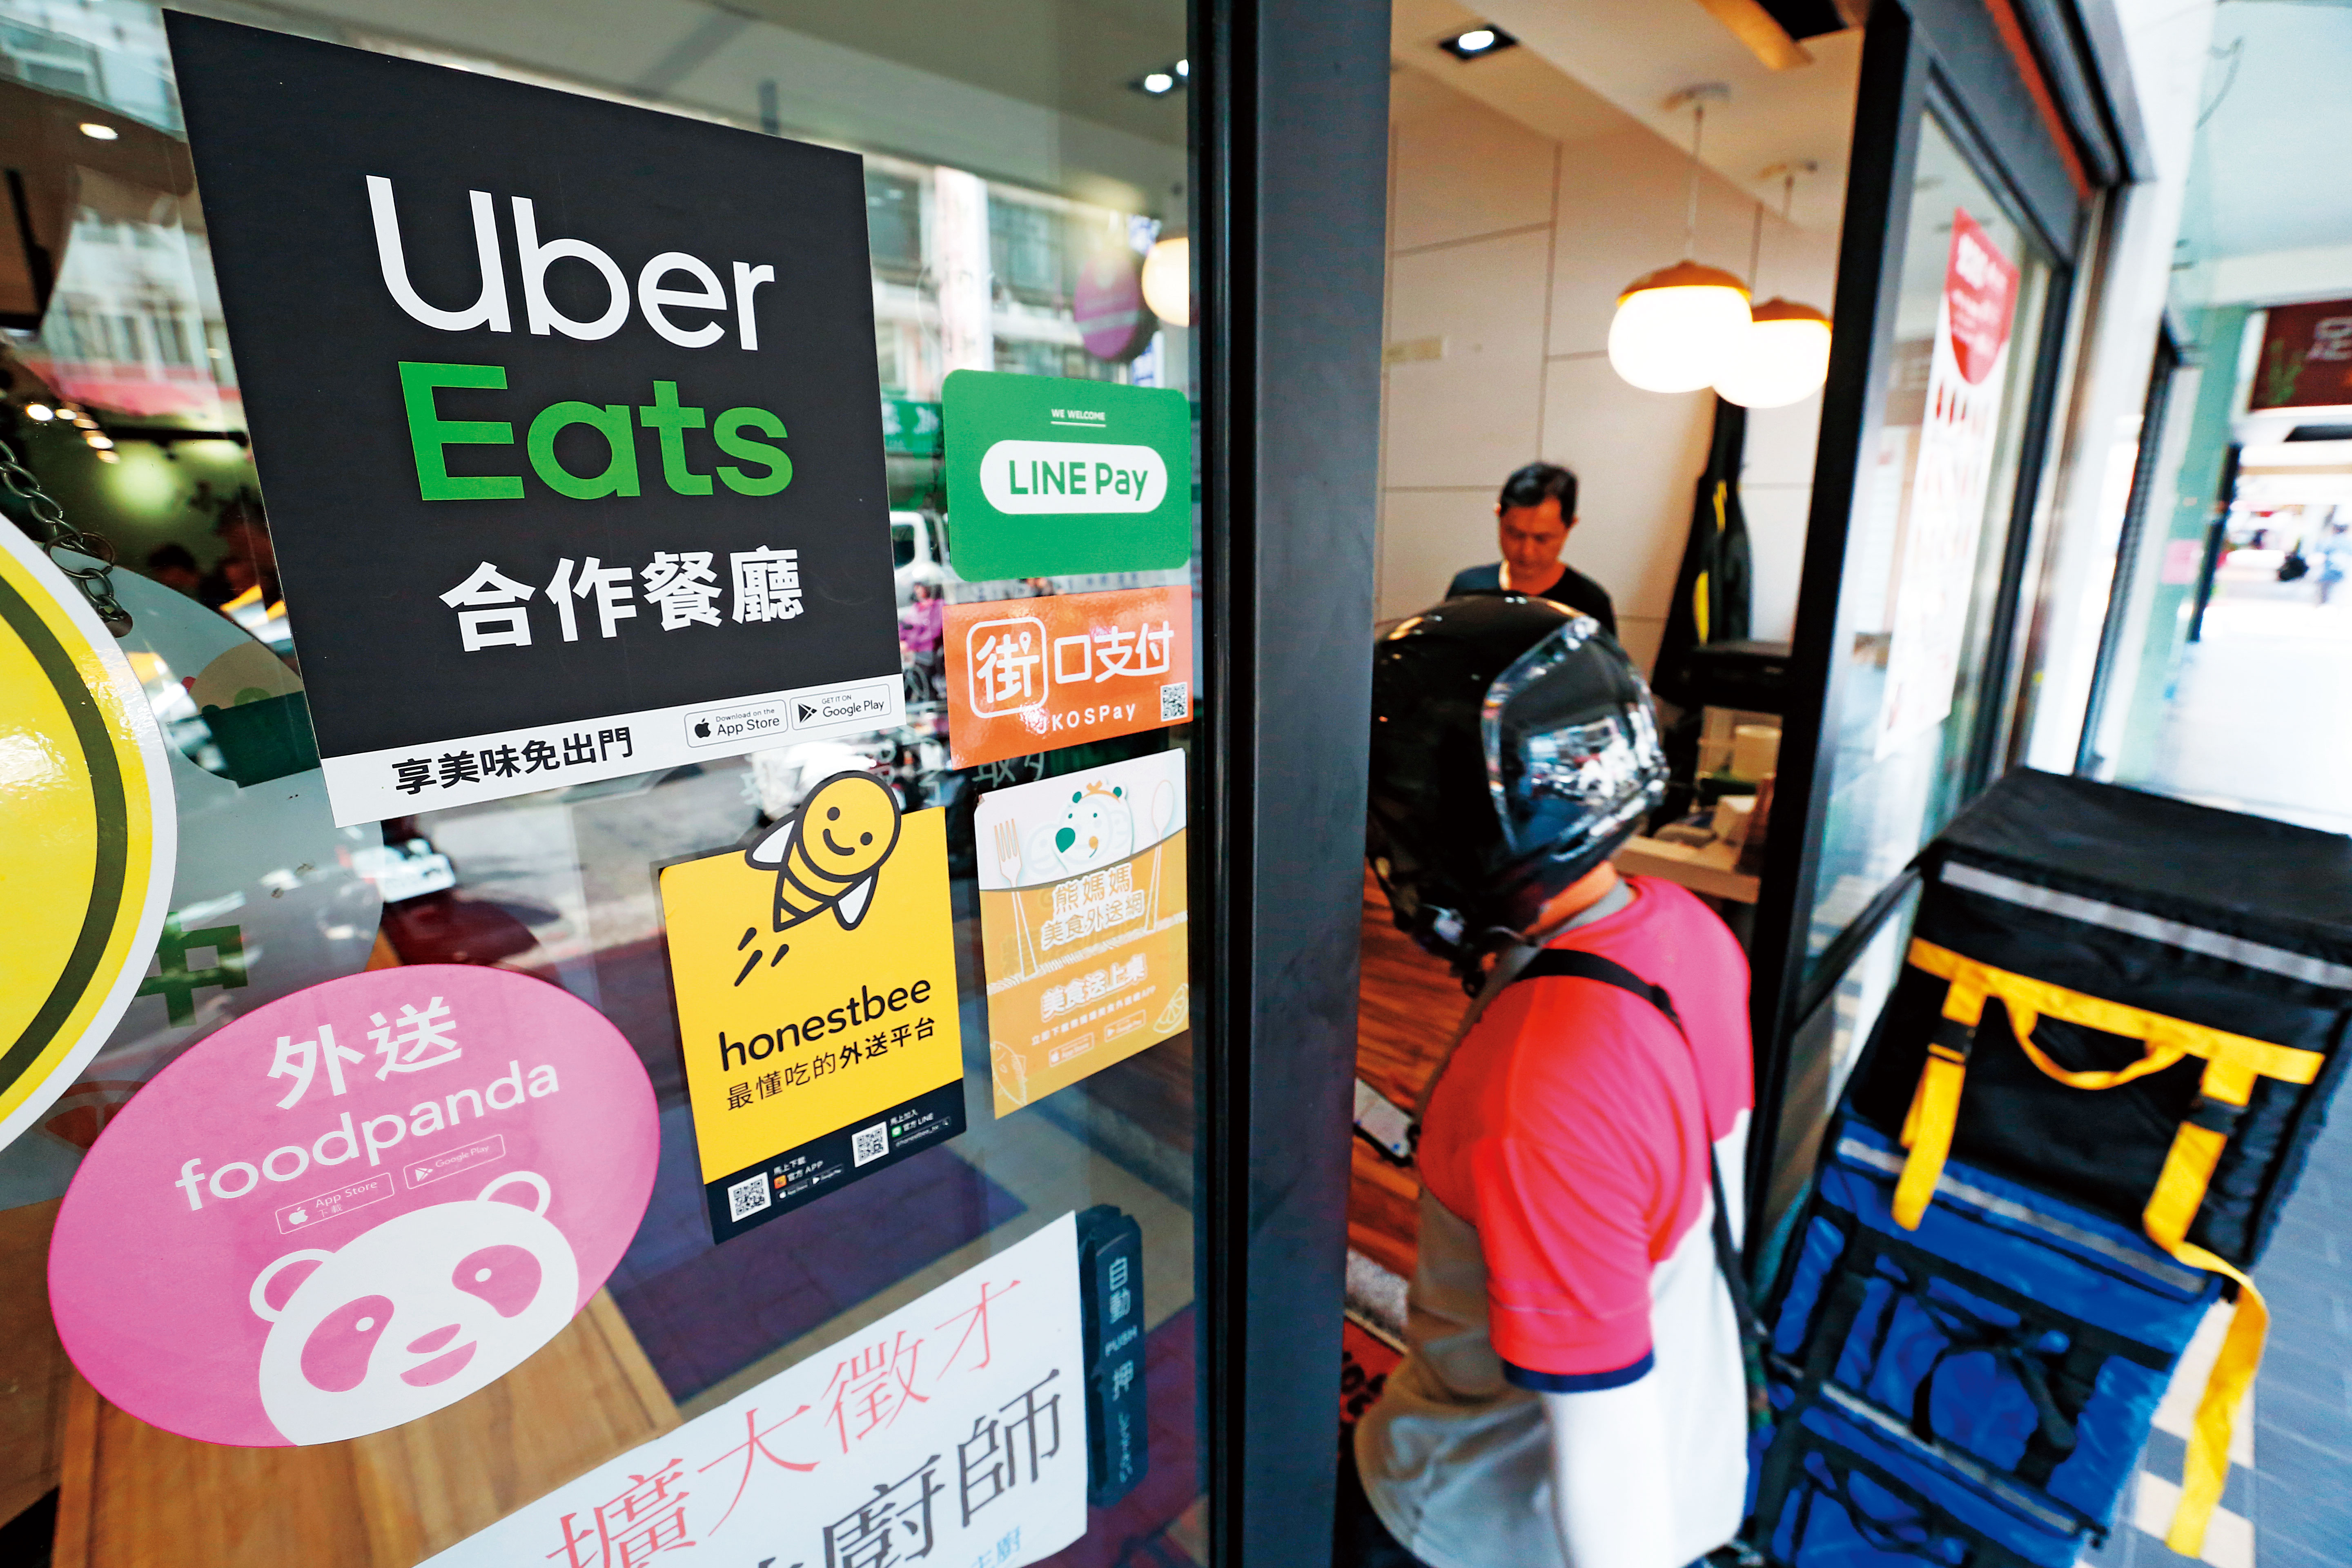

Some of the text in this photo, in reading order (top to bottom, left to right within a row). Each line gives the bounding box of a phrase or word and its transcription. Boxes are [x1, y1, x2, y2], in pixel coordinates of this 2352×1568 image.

[365, 175, 775, 350] Uber
[398, 361, 793, 500] Eats
[1051, 409, 1105, 421] WE WELCOME
[1009, 460, 1148, 501] LINE Pay
[439, 545, 804, 652] 合作餐廳
[975, 620, 1174, 704] 街口支付
[716, 711, 751, 722] Download
[717, 717, 780, 737] App Store
[823, 699, 884, 718] Google Play
[1036, 703, 1136, 735] JKOSPay
[392, 726, 633, 796] 享美味免出門
[1043, 892, 1143, 948] 美食外送網
[1054, 864, 1131, 915] 熊媽媽
[266, 996, 462, 1110] 外送
[718, 980, 931, 1071] honestbee
[727, 1017, 935, 1111] 最懂吃的外送平台
[175, 1060, 560, 1211] foodpanda
[435, 1152, 470, 1167] Google
[470, 1145, 490, 1156] Play
[316, 1182, 377, 1208] App Store
[1109, 1255, 1131, 1325] 自動
[547, 1280, 1021, 1568] 擴大徵才
